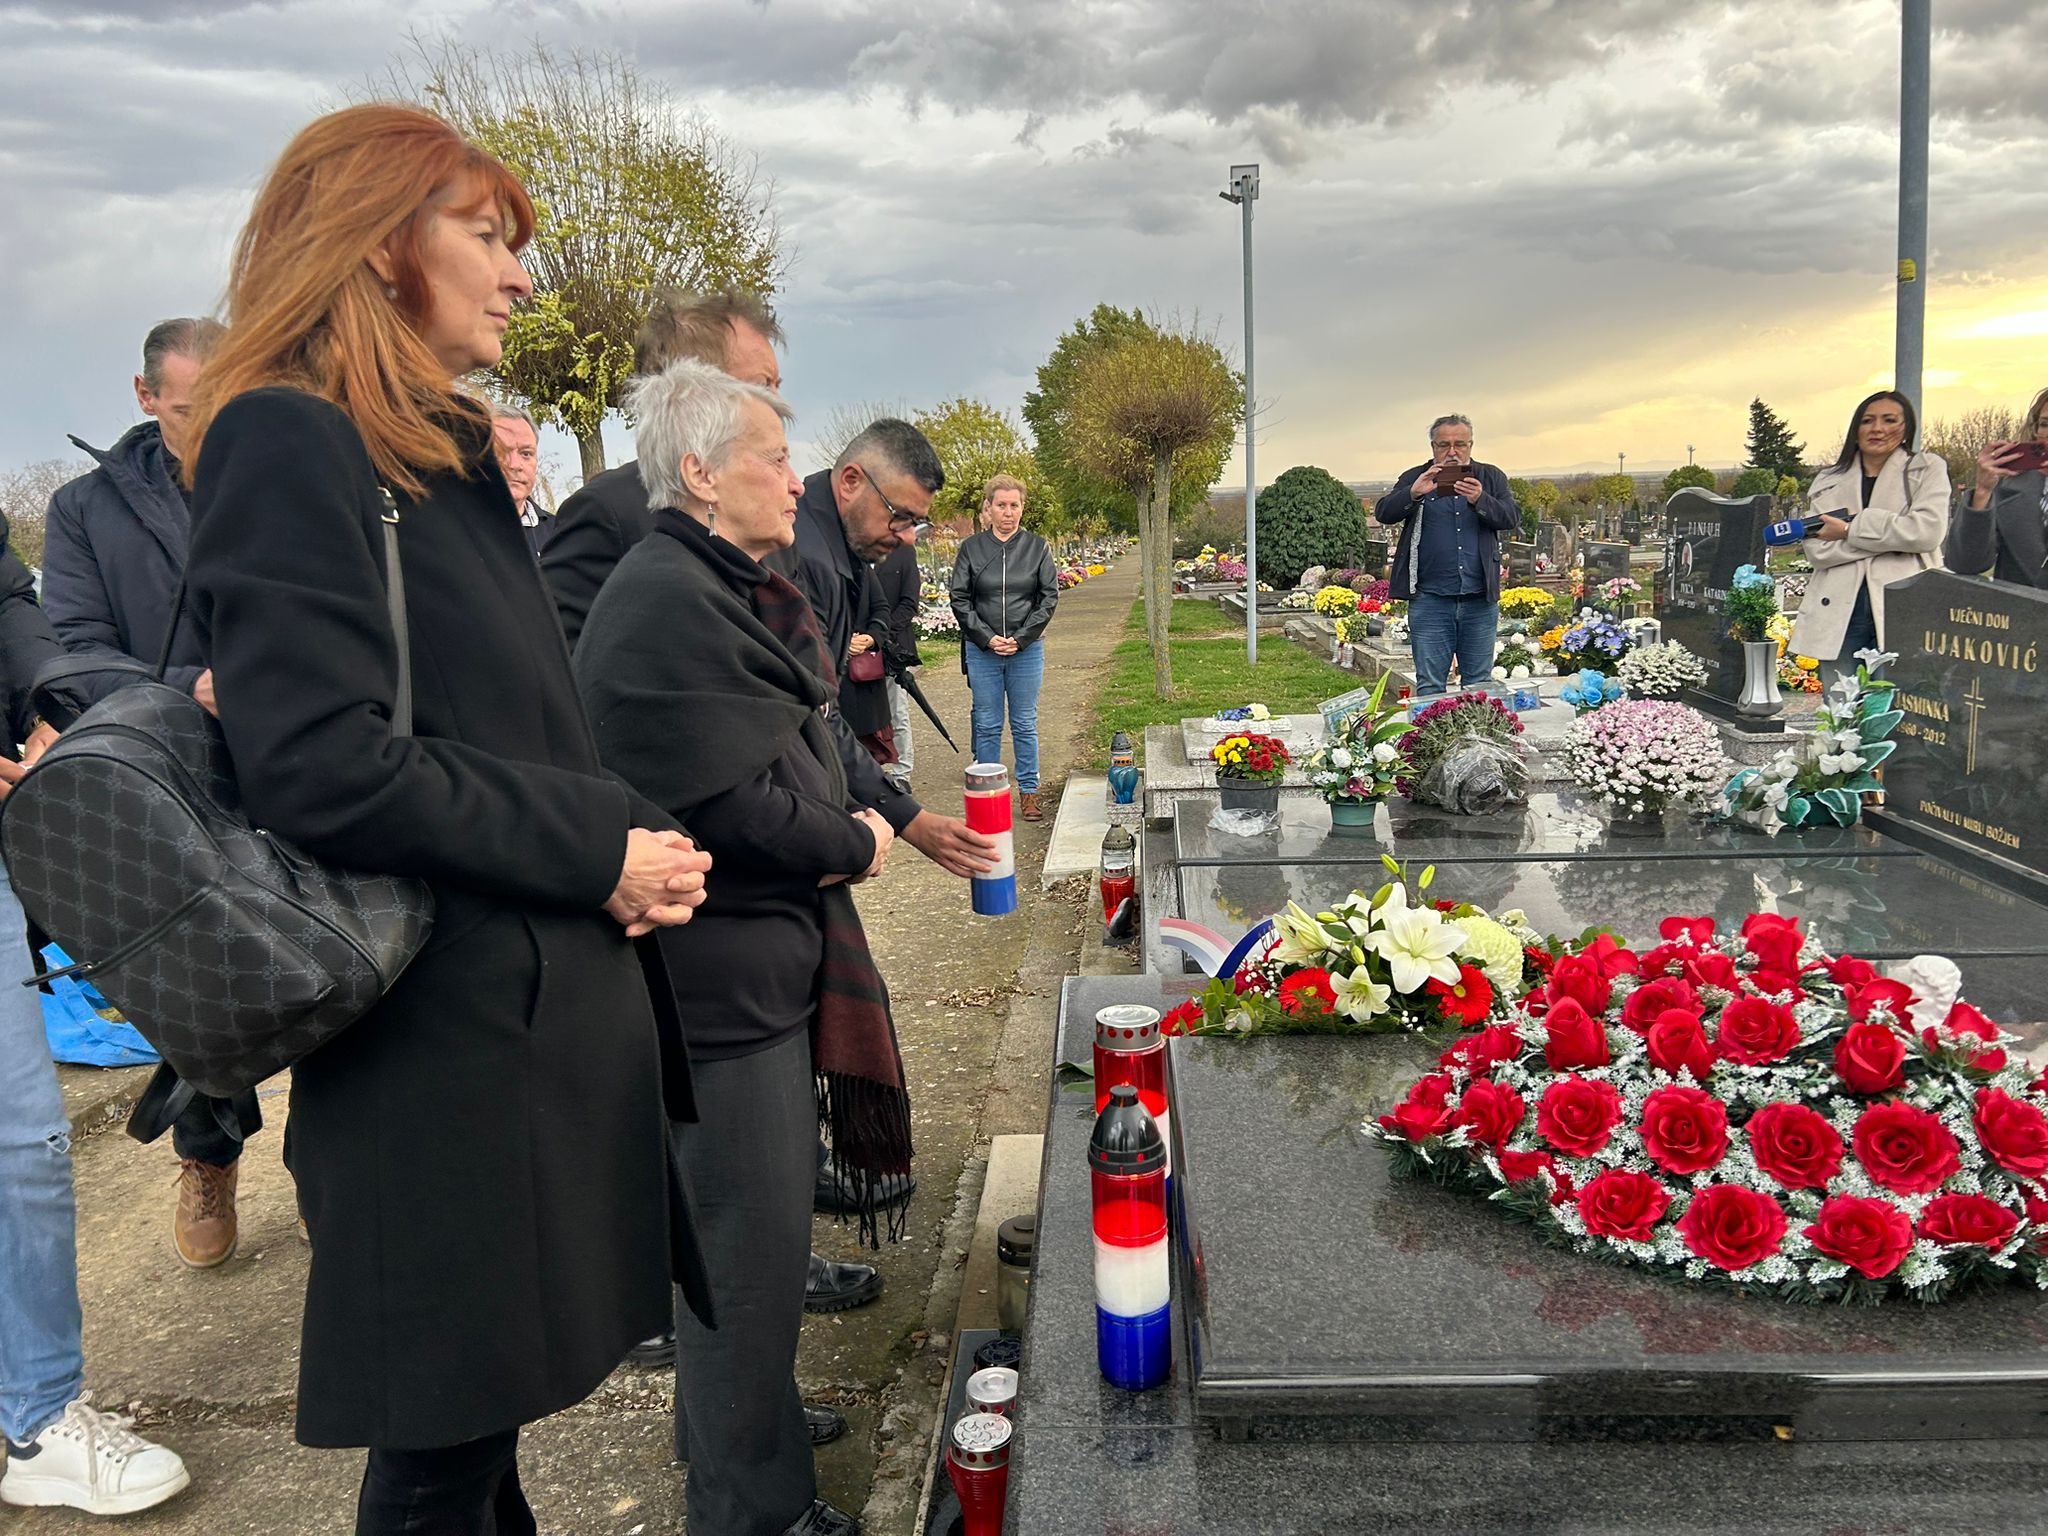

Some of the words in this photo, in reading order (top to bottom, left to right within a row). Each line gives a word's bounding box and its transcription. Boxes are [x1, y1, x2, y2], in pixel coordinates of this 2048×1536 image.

[1949, 606, 1983, 626] VJEČNI
[1985, 612, 2010, 630] DOM
[1924, 630, 2037, 673] UJAKOVIĆ
[1922, 727, 1946, 746] 2012
[1955, 813, 1963, 826] U
